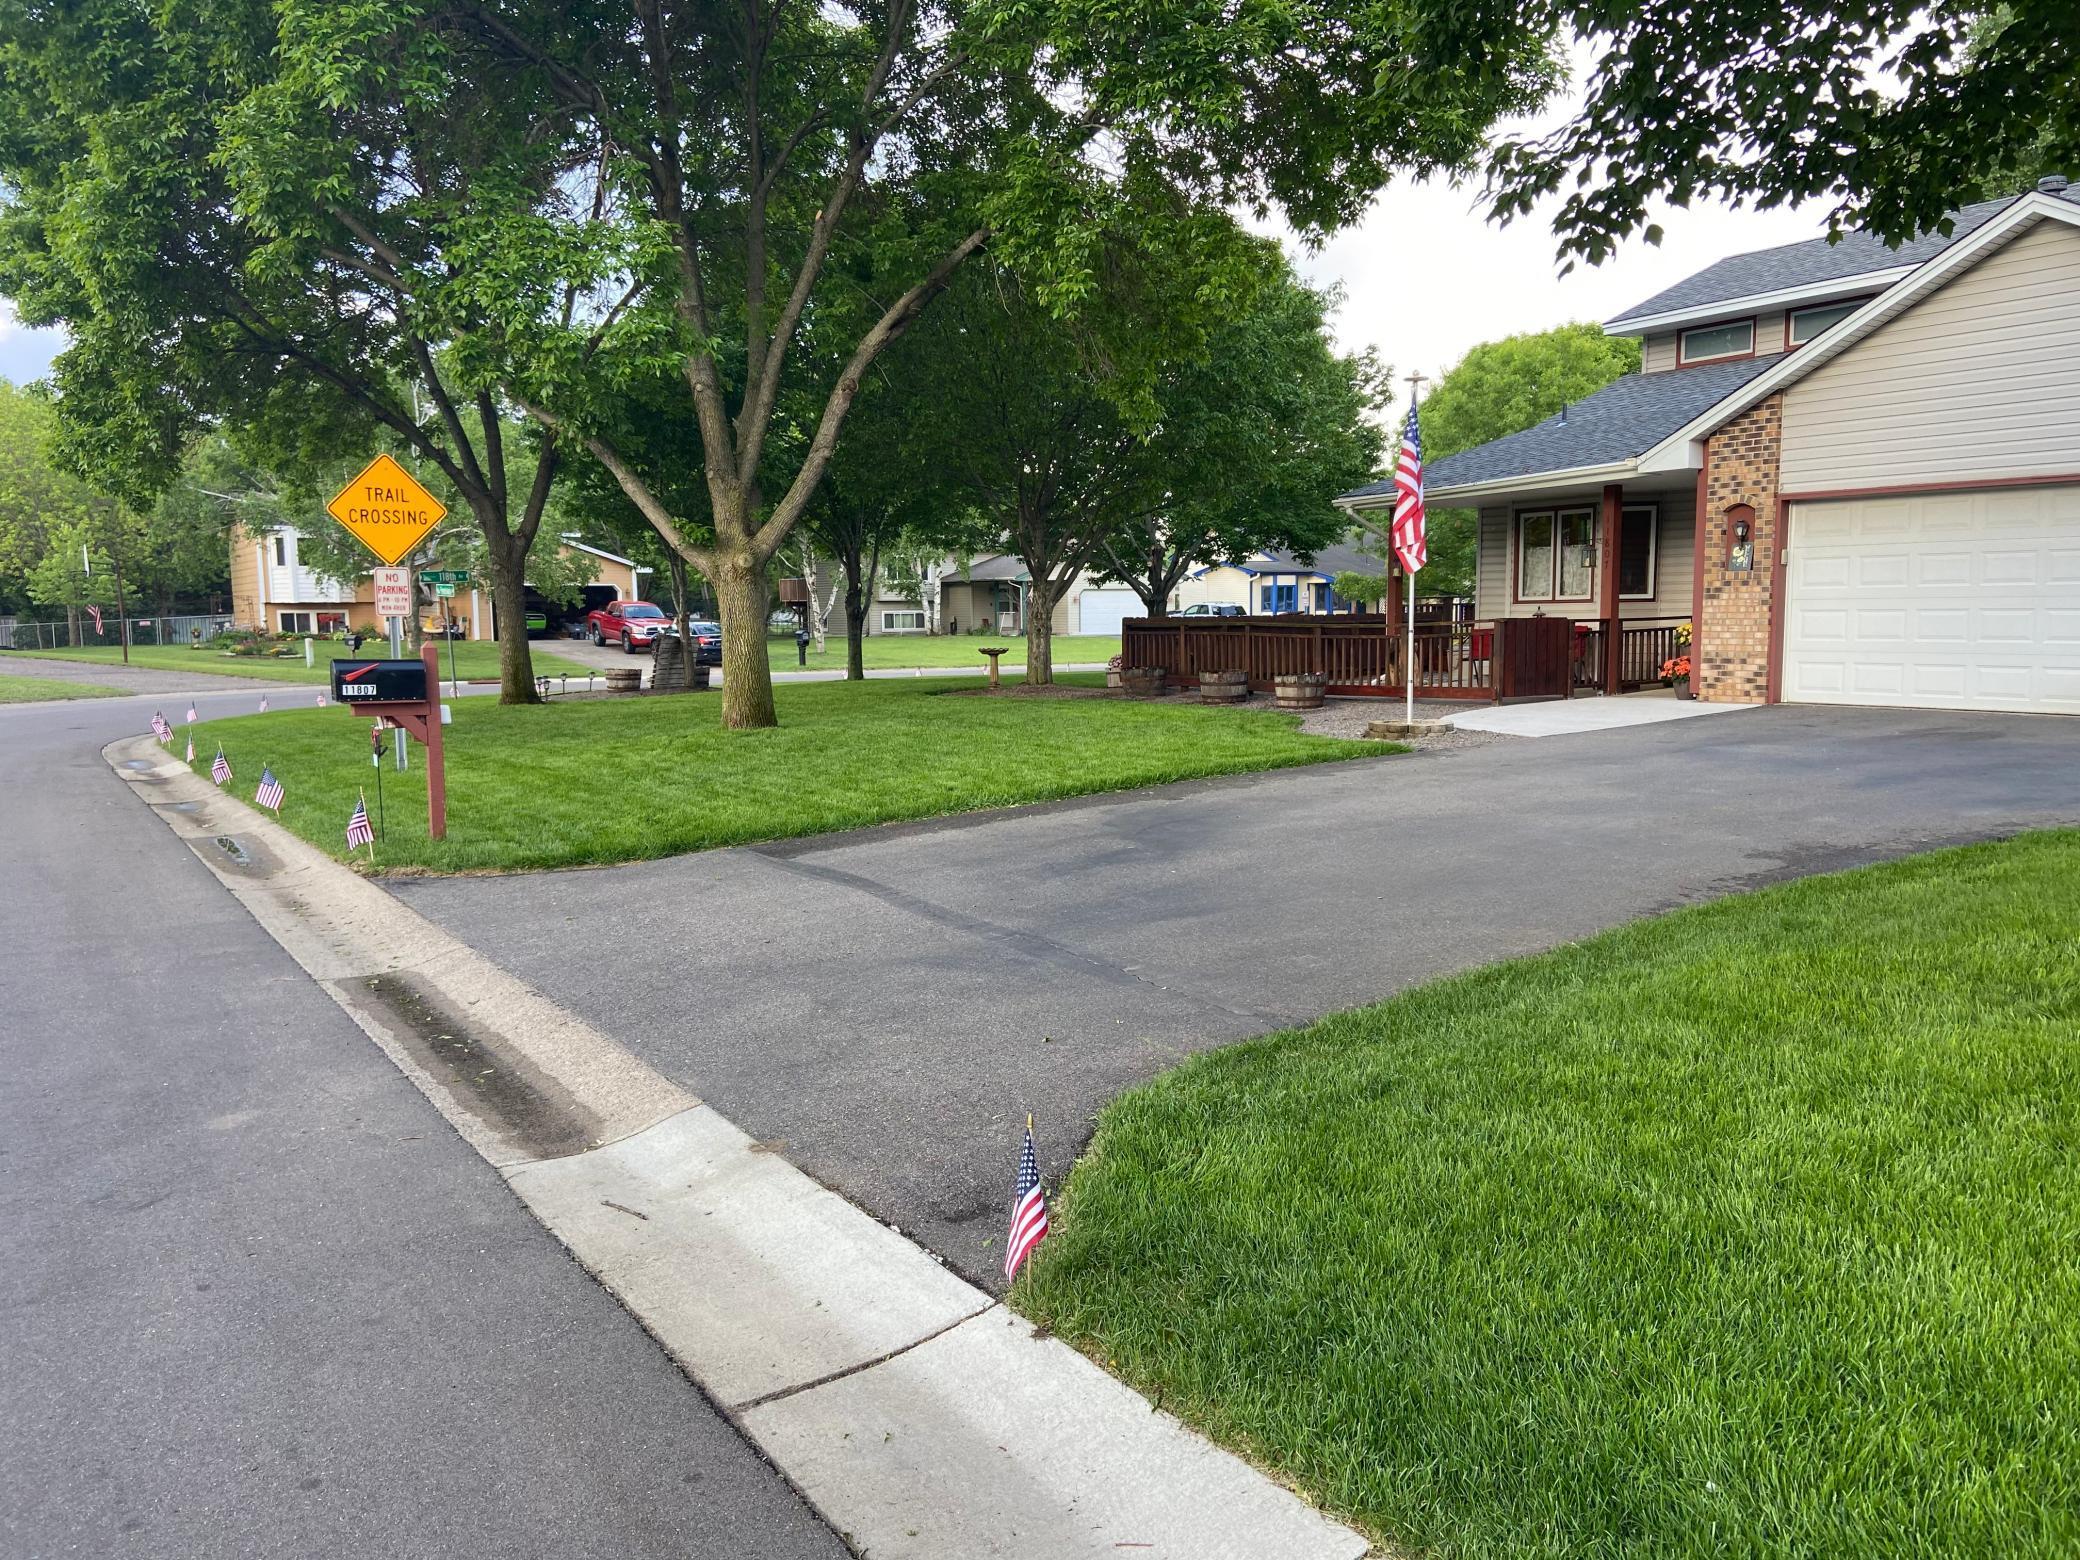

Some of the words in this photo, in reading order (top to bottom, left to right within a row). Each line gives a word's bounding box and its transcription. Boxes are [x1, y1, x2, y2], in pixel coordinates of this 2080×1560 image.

[365, 487, 409, 503] TRAIL
[348, 508, 428, 525] CROSSING
[385, 573, 399, 583] NO
[377, 585, 408, 595] PARKING
[345, 685, 376, 696] 11807
